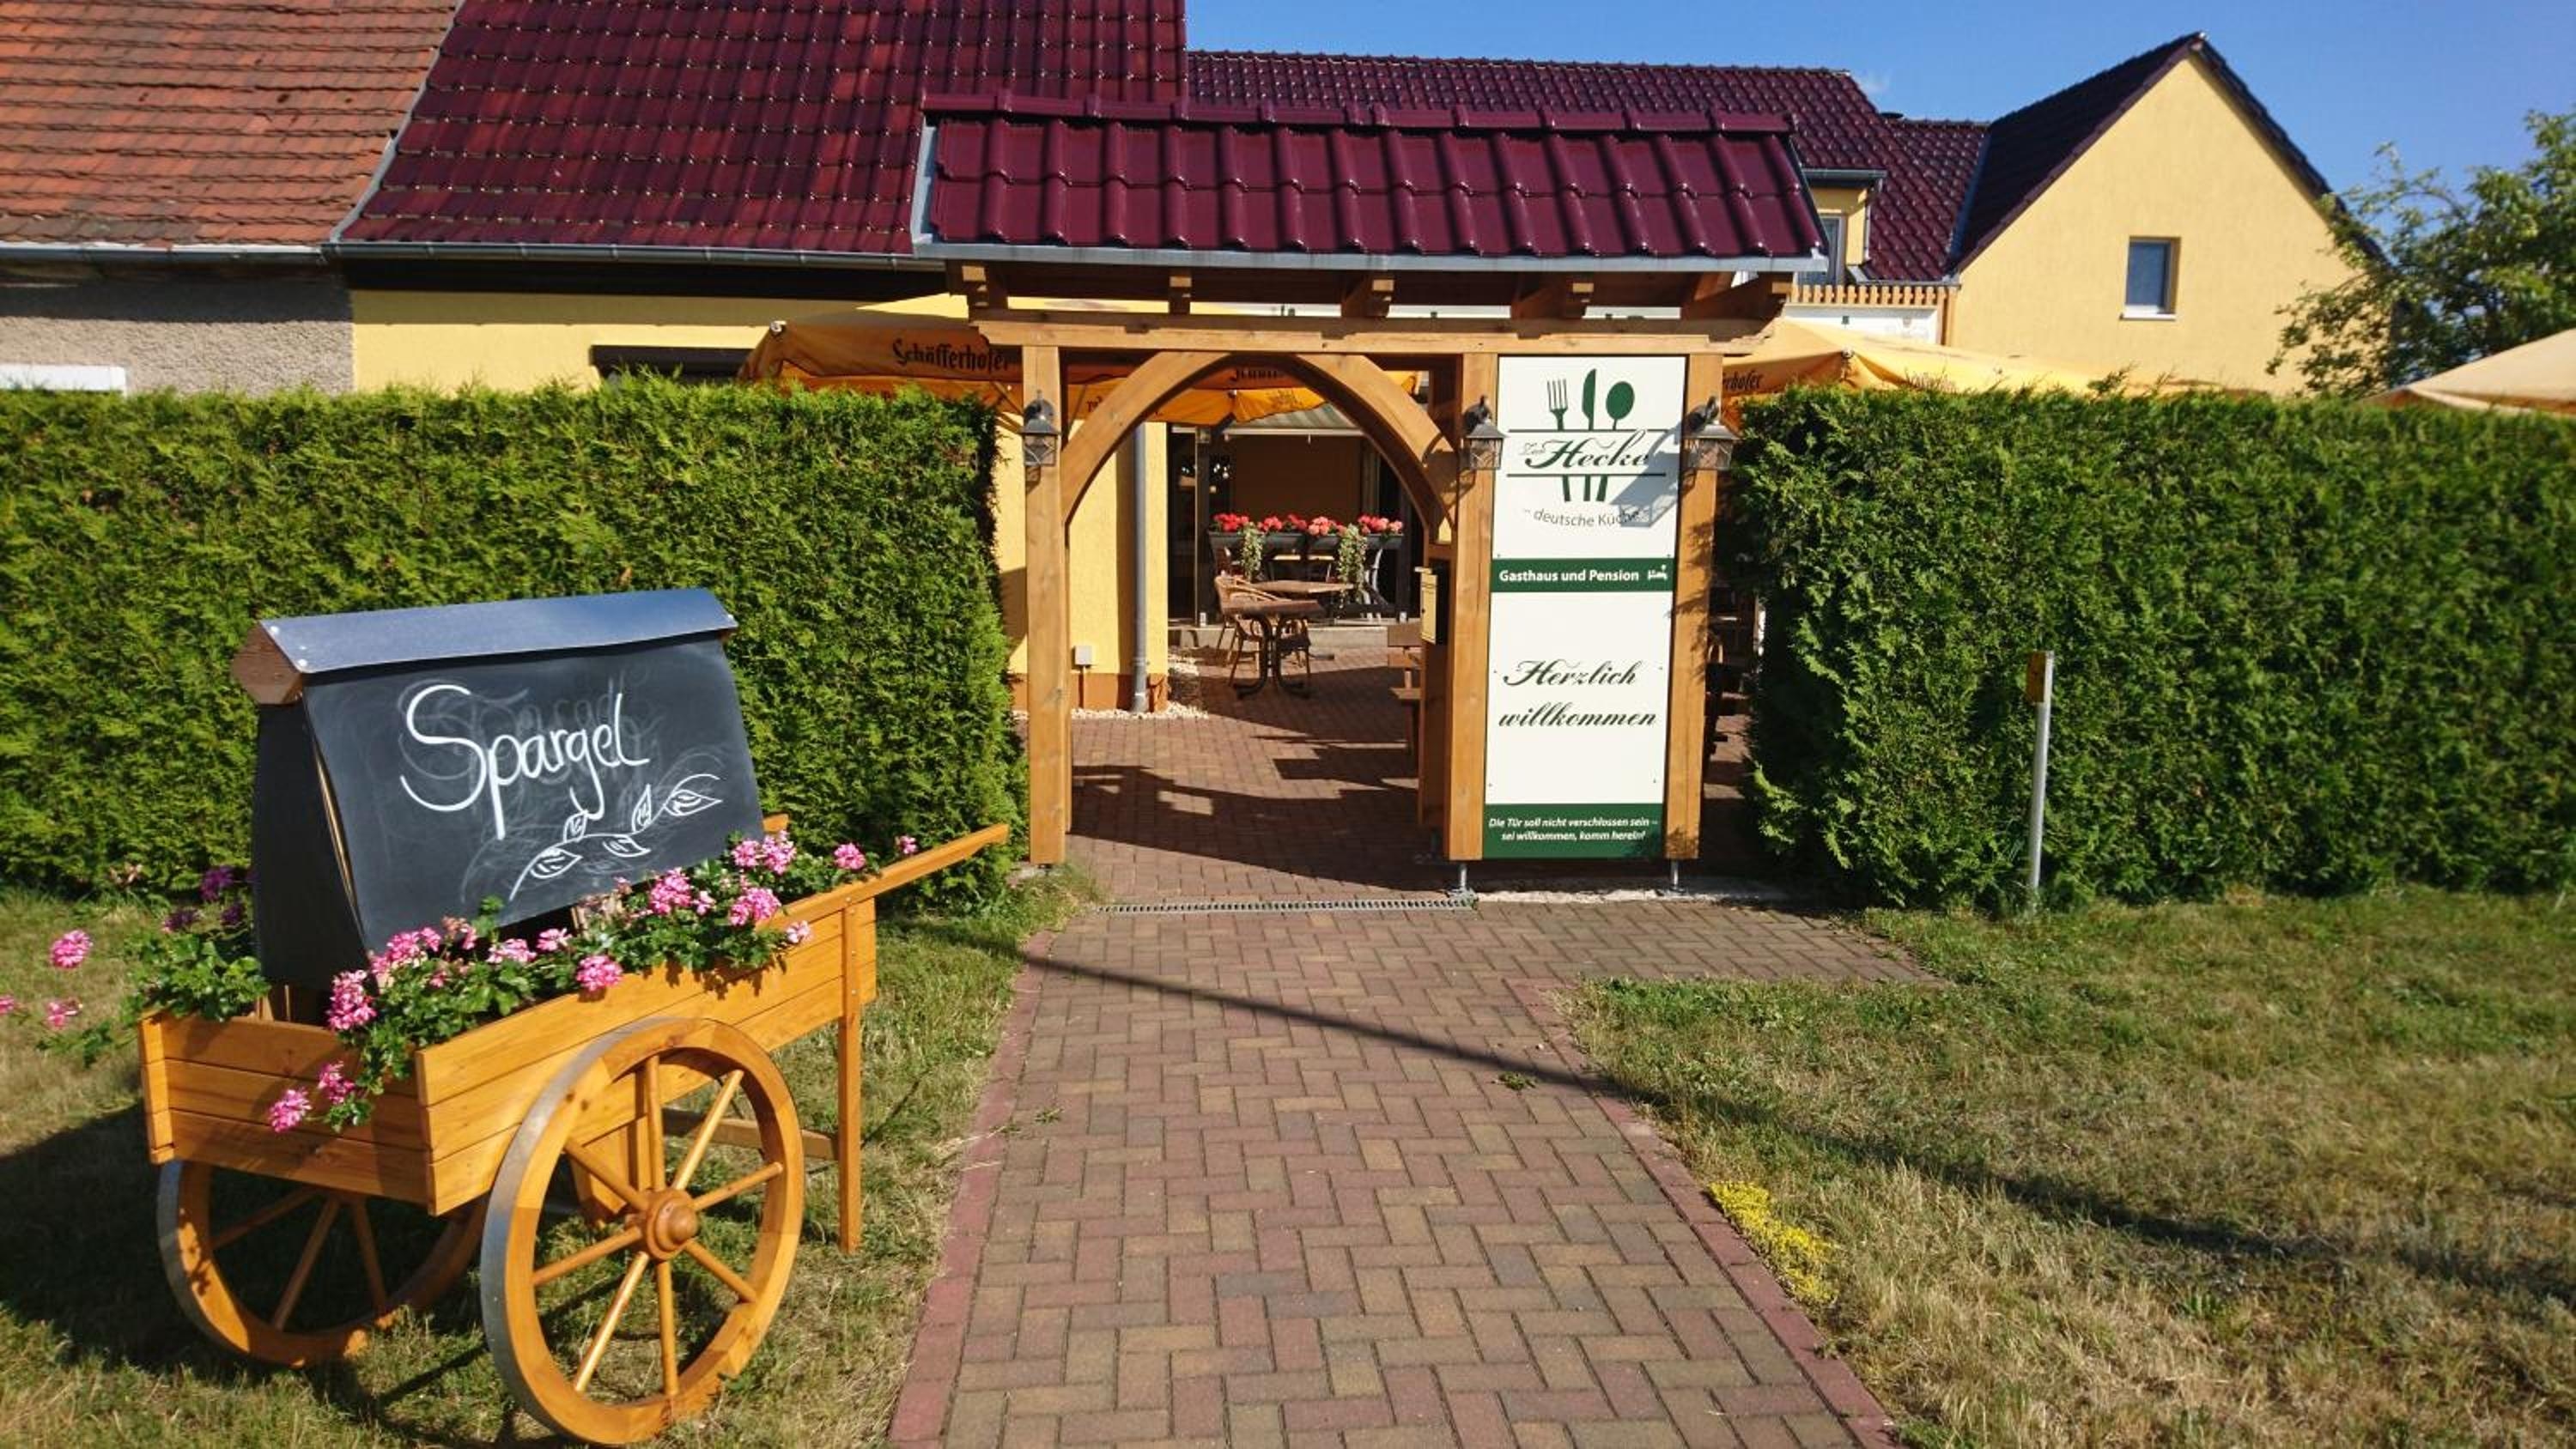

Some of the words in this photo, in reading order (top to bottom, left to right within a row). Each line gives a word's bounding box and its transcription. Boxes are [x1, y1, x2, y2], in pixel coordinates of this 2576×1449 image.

[1524, 428, 1649, 469] Hecke
[1534, 508, 1595, 527] deutsche
[1499, 570, 1558, 582] Gasthaus
[1561, 570, 1587, 582] und
[1589, 570, 1639, 582] Pension
[1503, 659, 1643, 687] Herzlich
[1498, 702, 1657, 728] willkommen
[399, 684, 651, 840] Spargel
[1488, 817, 1505, 828] Die
[1507, 817, 1522, 828] Tür
[1524, 817, 1541, 828] soll
[1542, 817, 1567, 828] nicht
[1568, 817, 1629, 828] verschlossen
[1630, 816, 1649, 828] sein
[1501, 831, 1516, 841] sei
[1516, 830, 1577, 843] willkommen,
[1579, 831, 1610, 841] komm
